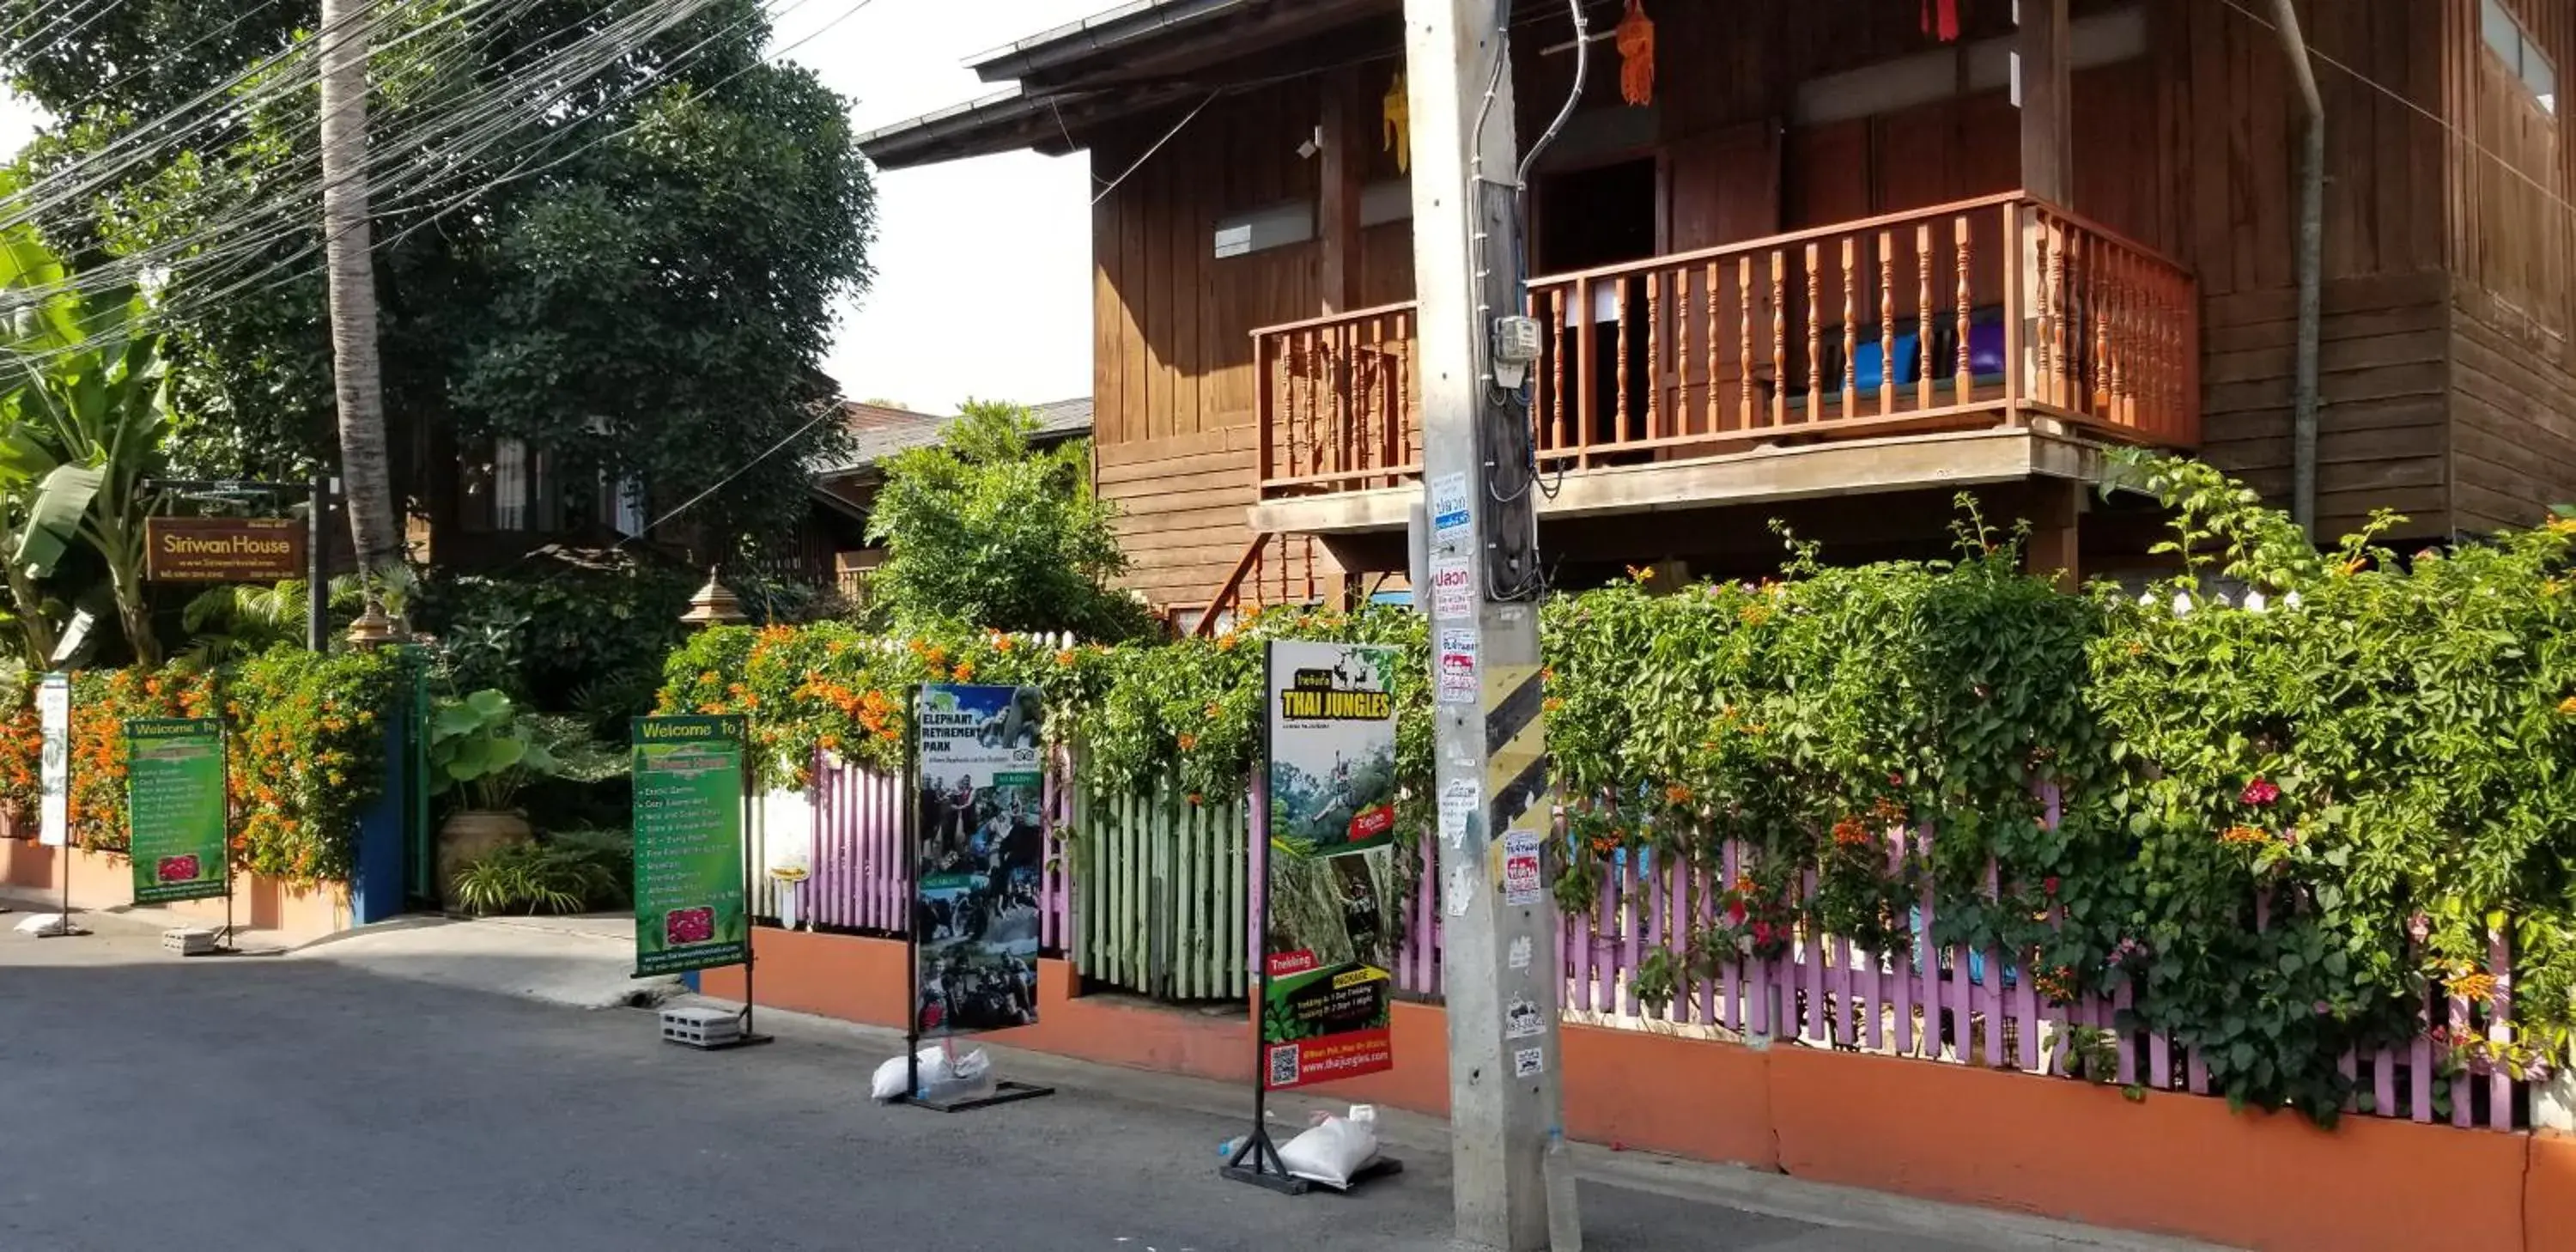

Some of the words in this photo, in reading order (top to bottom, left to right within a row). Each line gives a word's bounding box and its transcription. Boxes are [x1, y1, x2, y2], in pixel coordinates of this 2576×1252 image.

[164, 533, 231, 554] Siriwan
[233, 535, 290, 554] House
[1435, 568, 1468, 586] ปลวก
[1283, 691, 1321, 717] THAI
[1323, 691, 1390, 718] JUNGLES
[923, 714, 973, 725] ELEPHANT
[135, 724, 195, 736] Welcome
[642, 722, 713, 738] Welcome
[721, 719, 736, 735] to
[922, 726, 981, 738] RETIREMENT
[923, 741, 951, 752] PARK
[1271, 955, 1311, 971] Trekking
